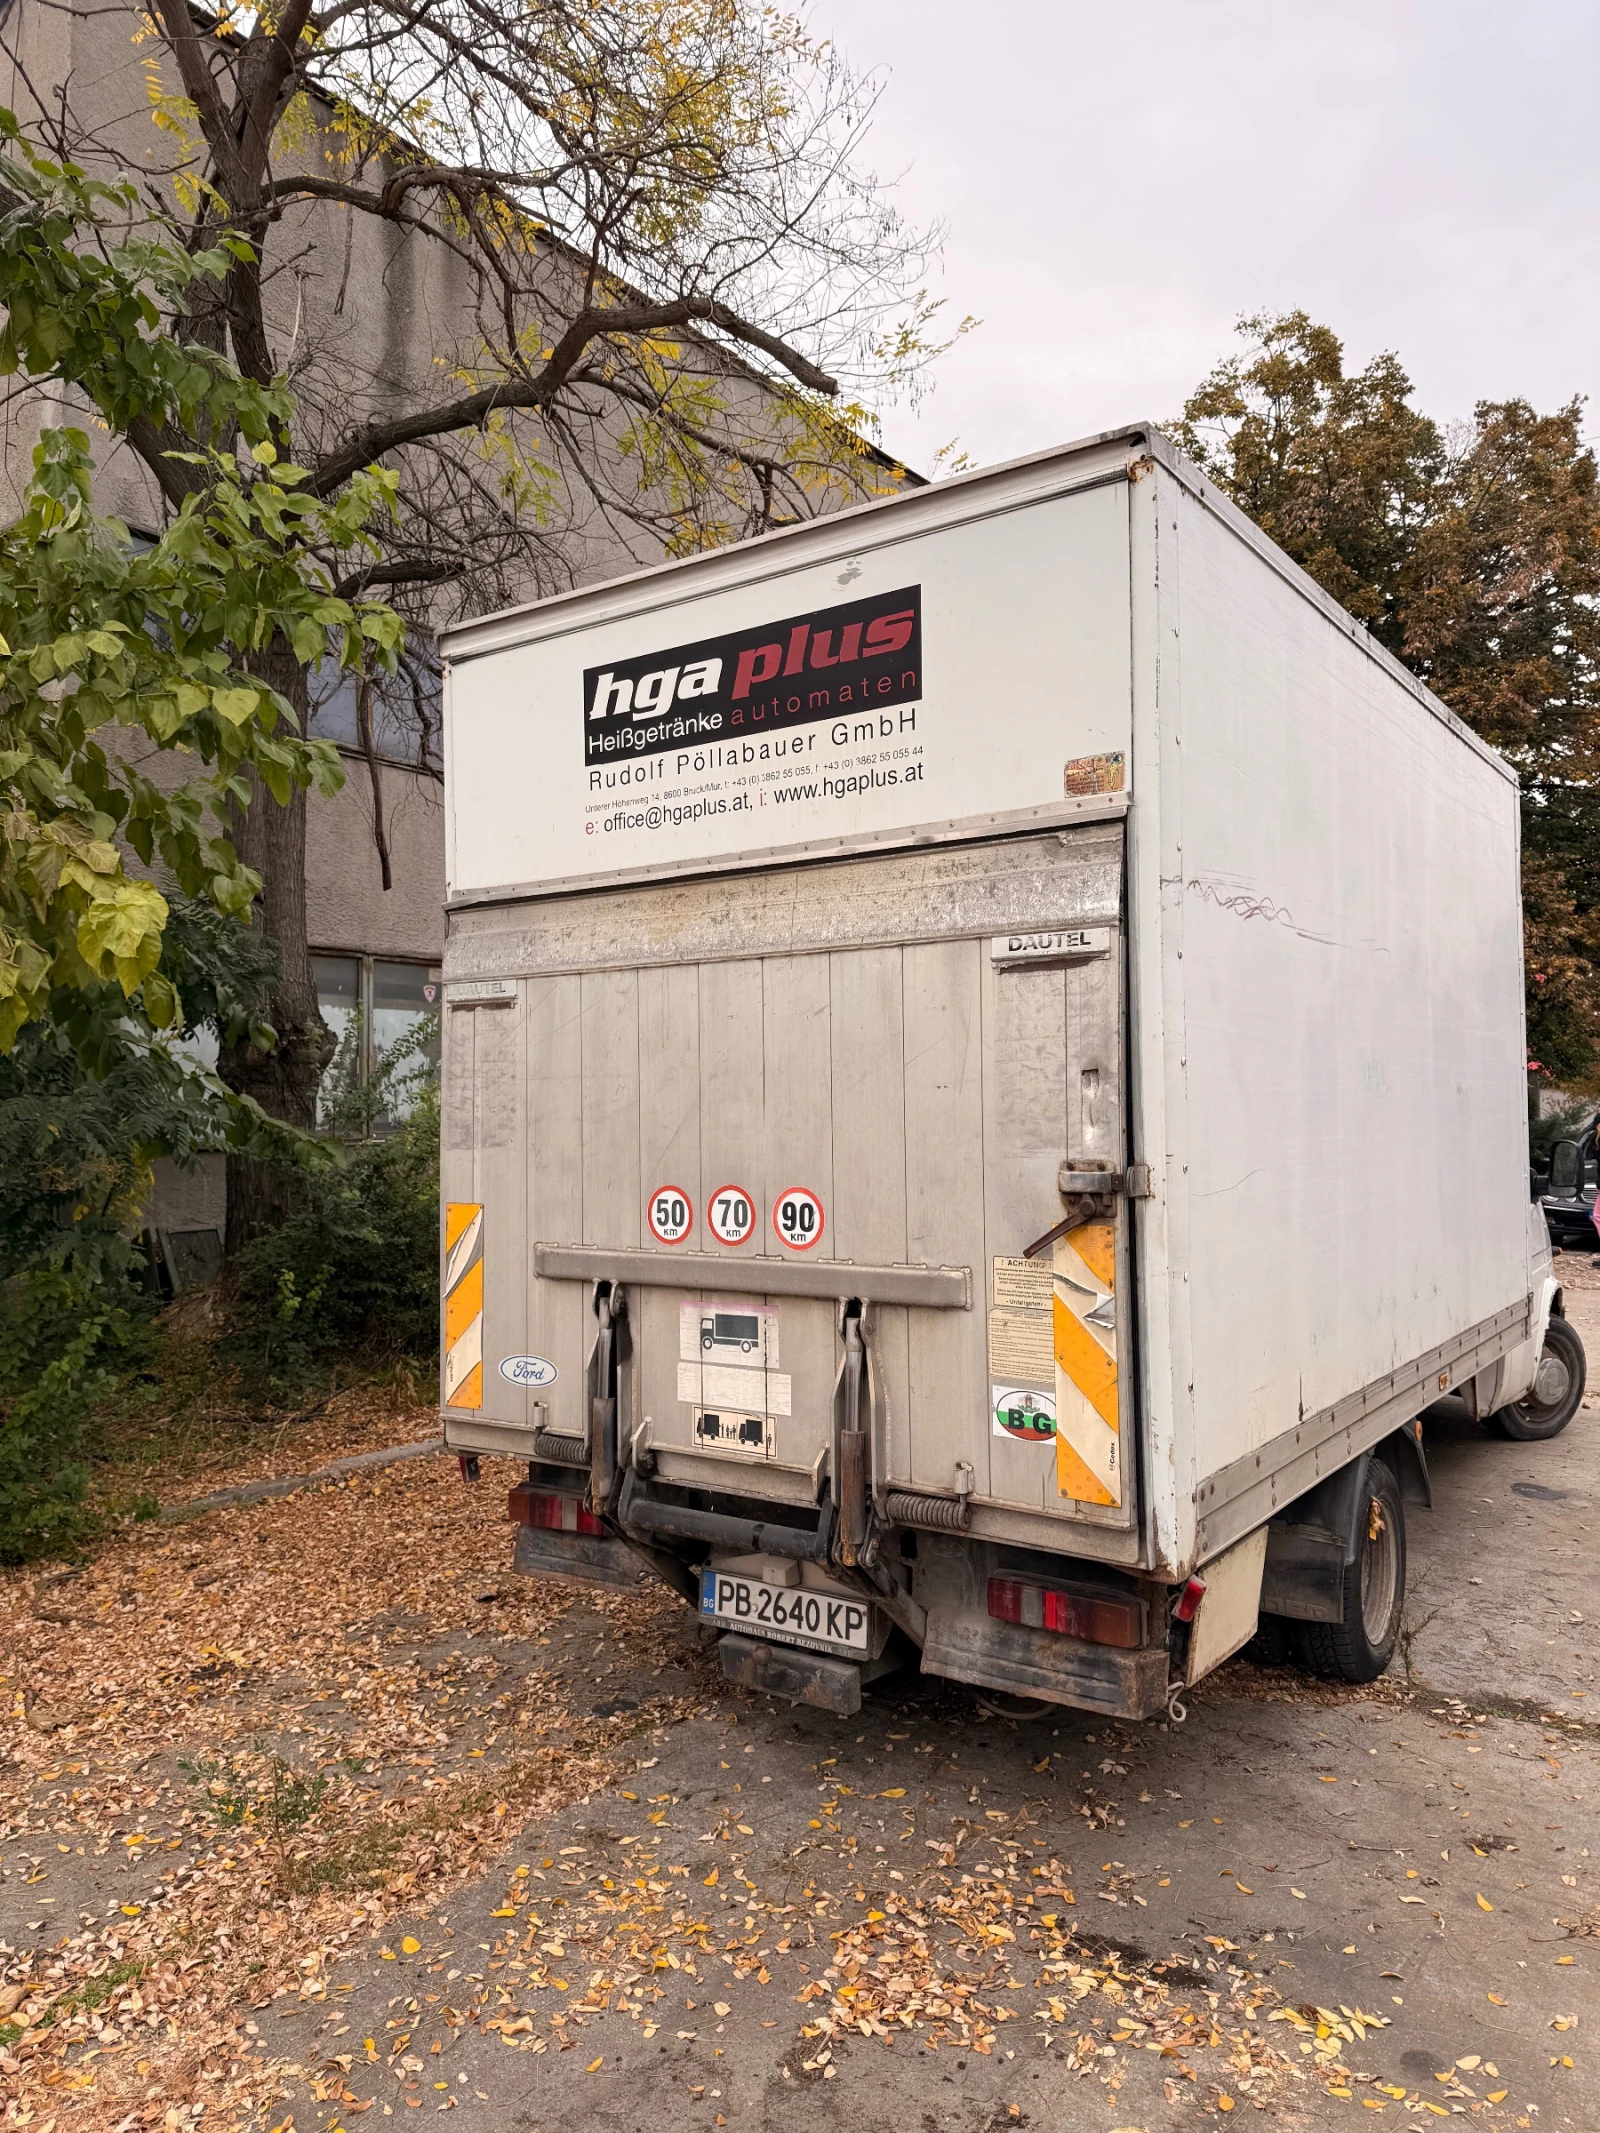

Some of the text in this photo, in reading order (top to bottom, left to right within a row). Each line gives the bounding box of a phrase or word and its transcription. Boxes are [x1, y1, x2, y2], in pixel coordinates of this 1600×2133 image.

[589, 609, 915, 722] hga plus
[588, 670, 917, 755] Heißgetränke automaten
[589, 708, 916, 791] Rudolf Pöllabauer GmbH
[585, 802, 611, 813] Unterer
[663, 788, 682, 800] 8600
[732, 777, 747, 786] +43
[748, 774, 760, 786] (0)
[761, 771, 781, 783] 3862
[782, 768, 793, 779] 55
[824, 761, 839, 770] +43
[841, 758, 854, 769] (0)
[855, 754, 877, 766] 3862
[879, 751, 891, 762] 55
[892, 748, 910, 760] 055
[912, 745, 924, 755] 44
[585, 762, 924, 835] e: office@hgaplus.at, i: www.hgaplus.at
[1008, 931, 1092, 952] DAUTEL
[656, 1198, 685, 1228] 50
[717, 1199, 749, 1228] 70
[782, 1201, 815, 1233] 90
[513, 1360, 545, 1380] Ford
[703, 1597, 714, 1609] BG
[718, 1579, 863, 1640] PB 2640 KP
[730, 1622, 767, 1638] AUTOHAUS
[766, 1630, 796, 1645] ROBERT
